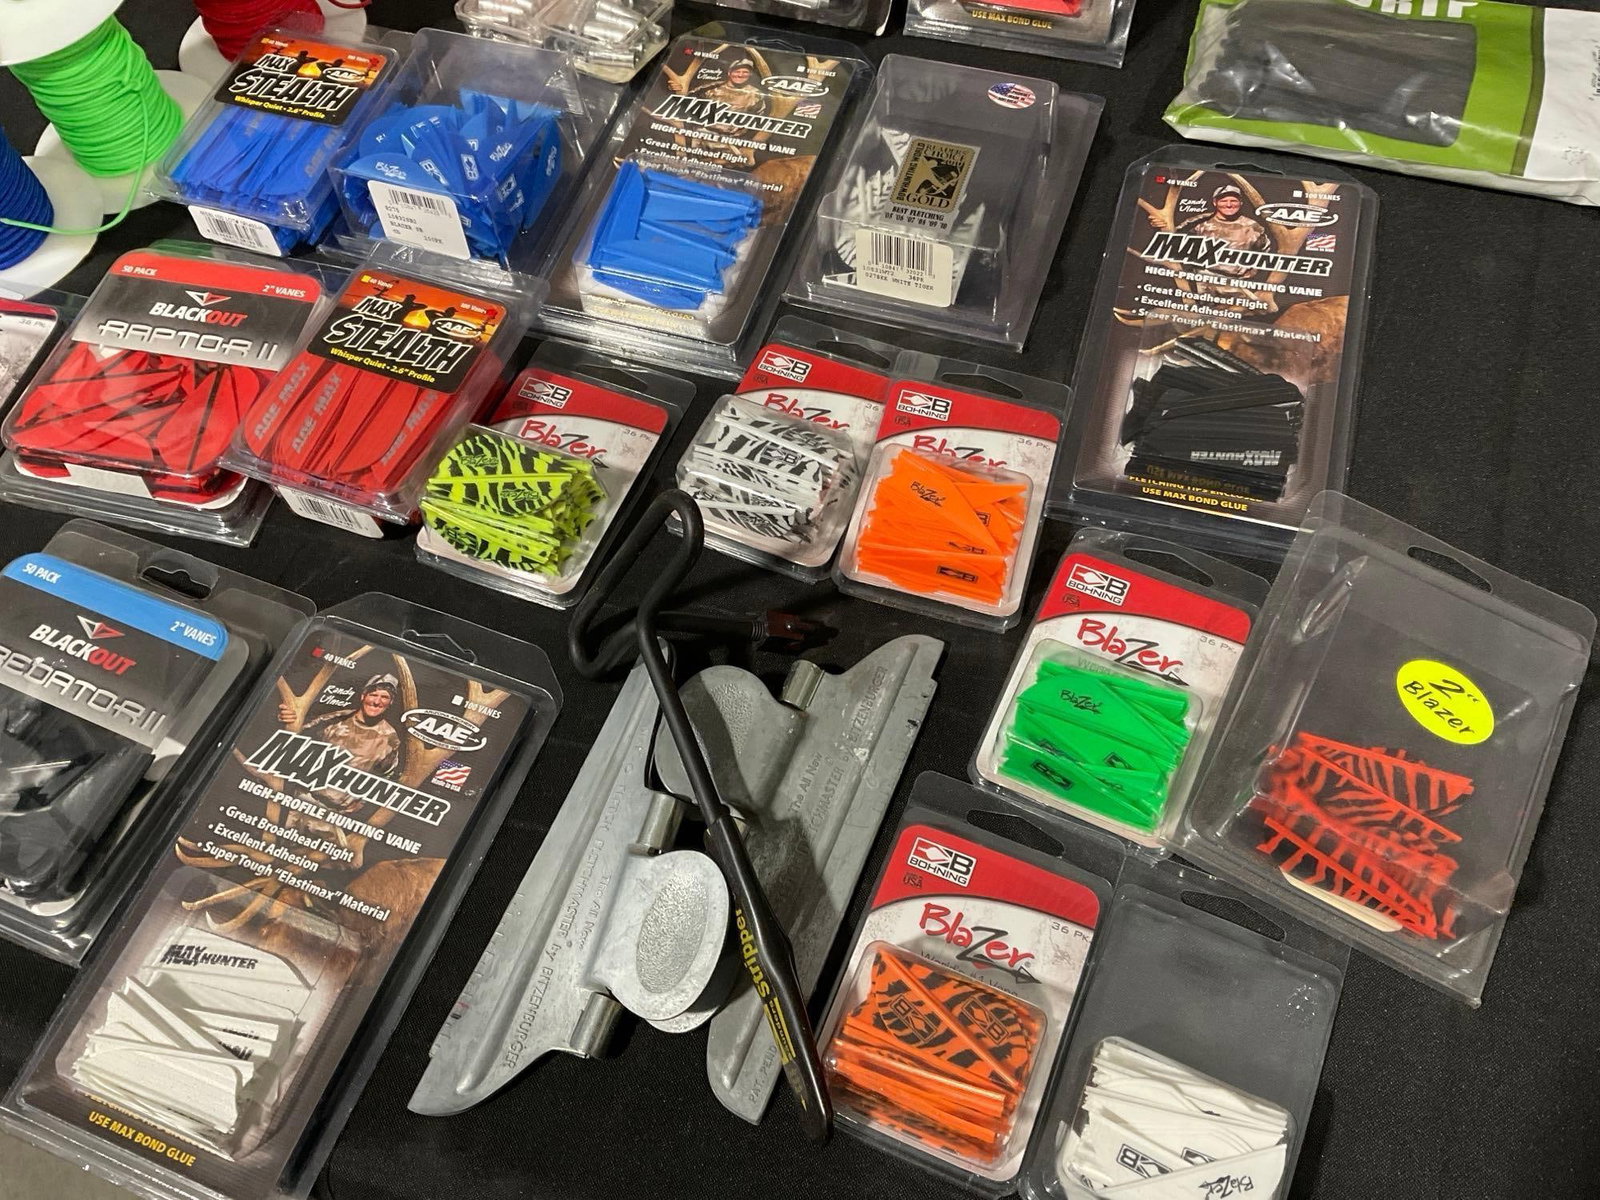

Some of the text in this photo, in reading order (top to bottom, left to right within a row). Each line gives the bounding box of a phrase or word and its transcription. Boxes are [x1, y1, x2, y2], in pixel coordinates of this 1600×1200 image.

[972, 9, 986, 19] USE
[988, 11, 1006, 22] MAX
[1007, 15, 1030, 26] BOND
[253, 53, 297, 73] MAX
[229, 69, 358, 111] STEALTH
[773, 79, 818, 93] AAE
[234, 95, 264, 110] Whisper
[263, 101, 283, 111] Quiet
[650, 122, 797, 156] HIGH-PROFILE HUNTING VANE
[645, 137, 748, 165] Great Broadhead Flight
[1176, 180, 1198, 188] VANES
[906, 192, 950, 209] GOLD
[1179, 198, 1207, 208] Randy
[1318, 193, 1341, 202] VANES
[892, 205, 945, 222] BEST FLETCHING
[1270, 208, 1323, 223] AAE
[122, 264, 158, 276] 50 PACK
[274, 285, 306, 298] VANES
[1145, 265, 1323, 298] HIGH-PROFILE HUNTING VANE
[352, 295, 403, 320] MAX
[1140, 295, 1242, 320] Excellent Adhesion
[1143, 284, 1268, 311] Great Broadhead Flight
[1171, 313, 1204, 328] Tough
[98, 320, 253, 359] RAPTOR
[323, 315, 473, 375] STEALTH
[330, 346, 362, 364] Whisper
[363, 356, 387, 371] Quiet
[408, 369, 436, 384] Profile
[759, 363, 804, 382] BOHNING
[519, 390, 564, 408] BOHNING
[897, 403, 947, 420] BOHNING
[1017, 437, 1032, 446] 36
[1142, 486, 1162, 497] USE
[1163, 489, 1187, 502] MAX
[1188, 493, 1219, 507] BOND
[1219, 498, 1249, 512] GLUE
[22, 562, 62, 584] 50 PACK
[1067, 580, 1122, 605] BOHNING
[183, 622, 217, 647] VANES
[1199, 634, 1217, 645] 36
[323, 652, 357, 670] 40 VANES
[319, 694, 352, 708] Ulmer
[323, 684, 356, 700] Randy
[464, 700, 502, 719] 100 VANES
[1402, 680, 1475, 734] Blazer
[414, 716, 472, 746] AAE
[238, 777, 423, 855] HIGH-PROFILE HUNTING VANE
[225, 804, 354, 863] Great Broadhead Flight
[213, 822, 320, 873] Excellent Adhesion
[908, 855, 969, 886] BOHNING
[203, 840, 237, 867] Super
[237, 853, 274, 878] Tough
[339, 892, 392, 923] Material
[1050, 919, 1070, 933] 36
[502, 965, 555, 1070] BITZENBURGER
[89, 1110, 197, 1168] USE MAX BOND GLUE
